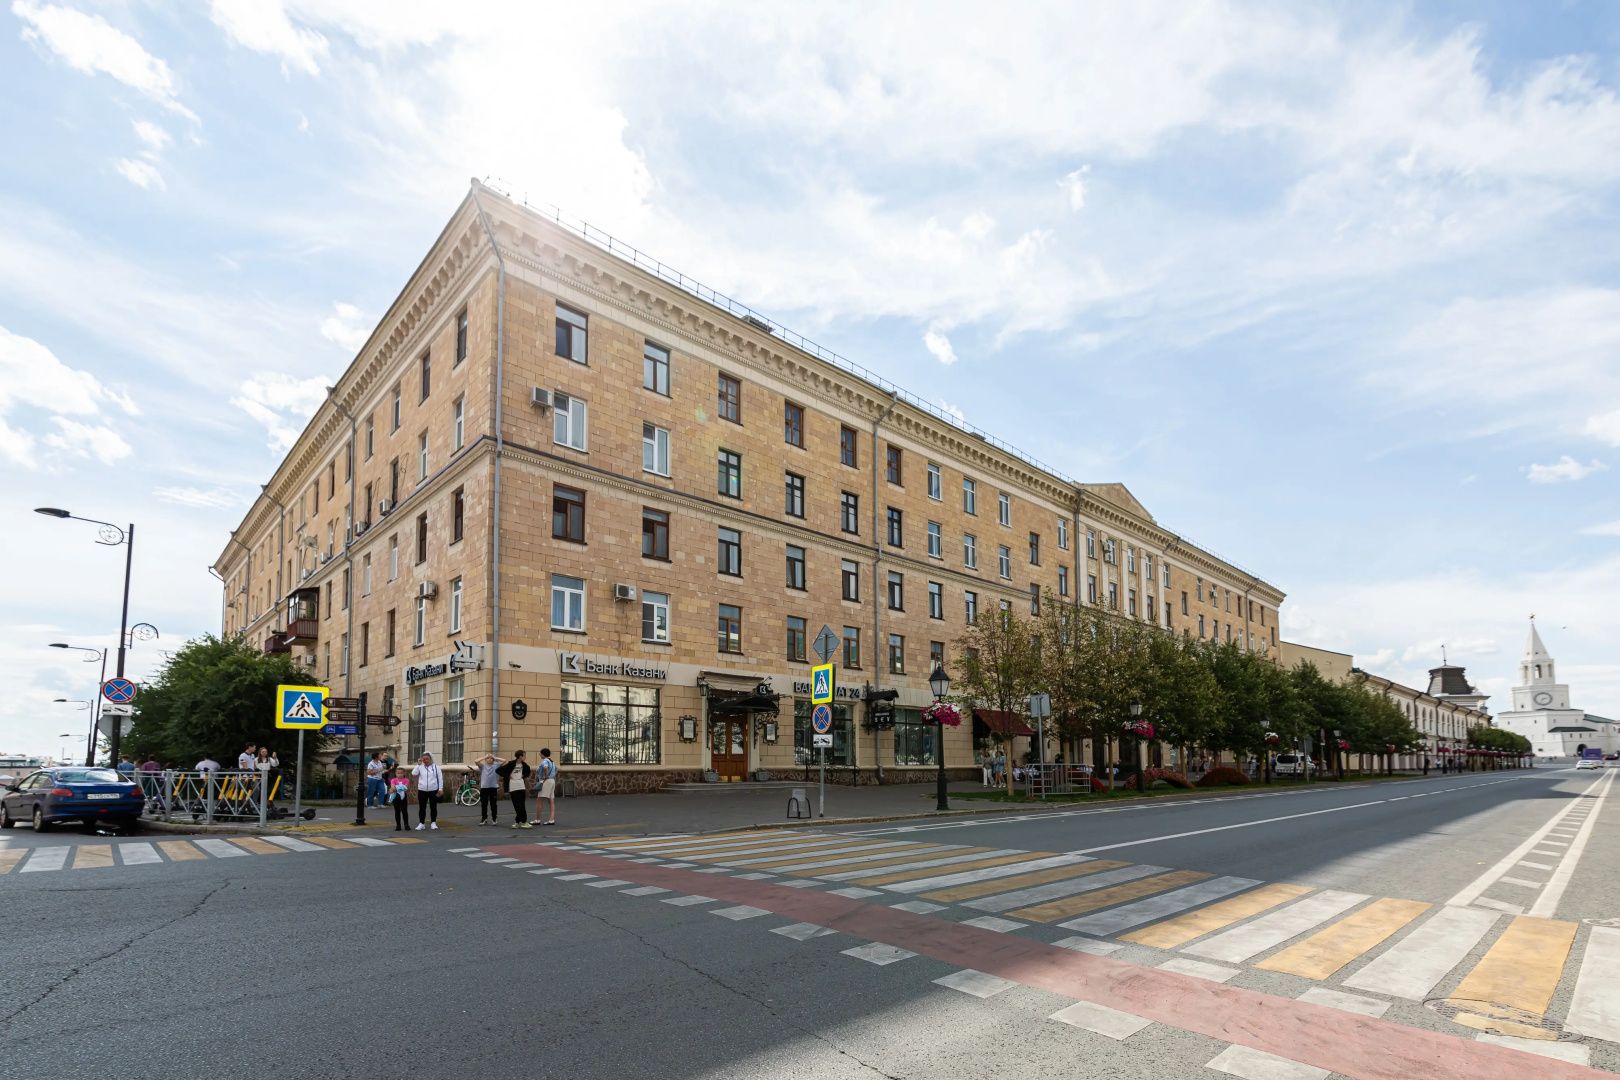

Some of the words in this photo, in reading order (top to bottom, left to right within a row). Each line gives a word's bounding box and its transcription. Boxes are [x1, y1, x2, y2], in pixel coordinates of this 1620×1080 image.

[586, 659, 620, 674] Банк
[622, 662, 667, 679] Казани
[849, 687, 861, 699] 24
